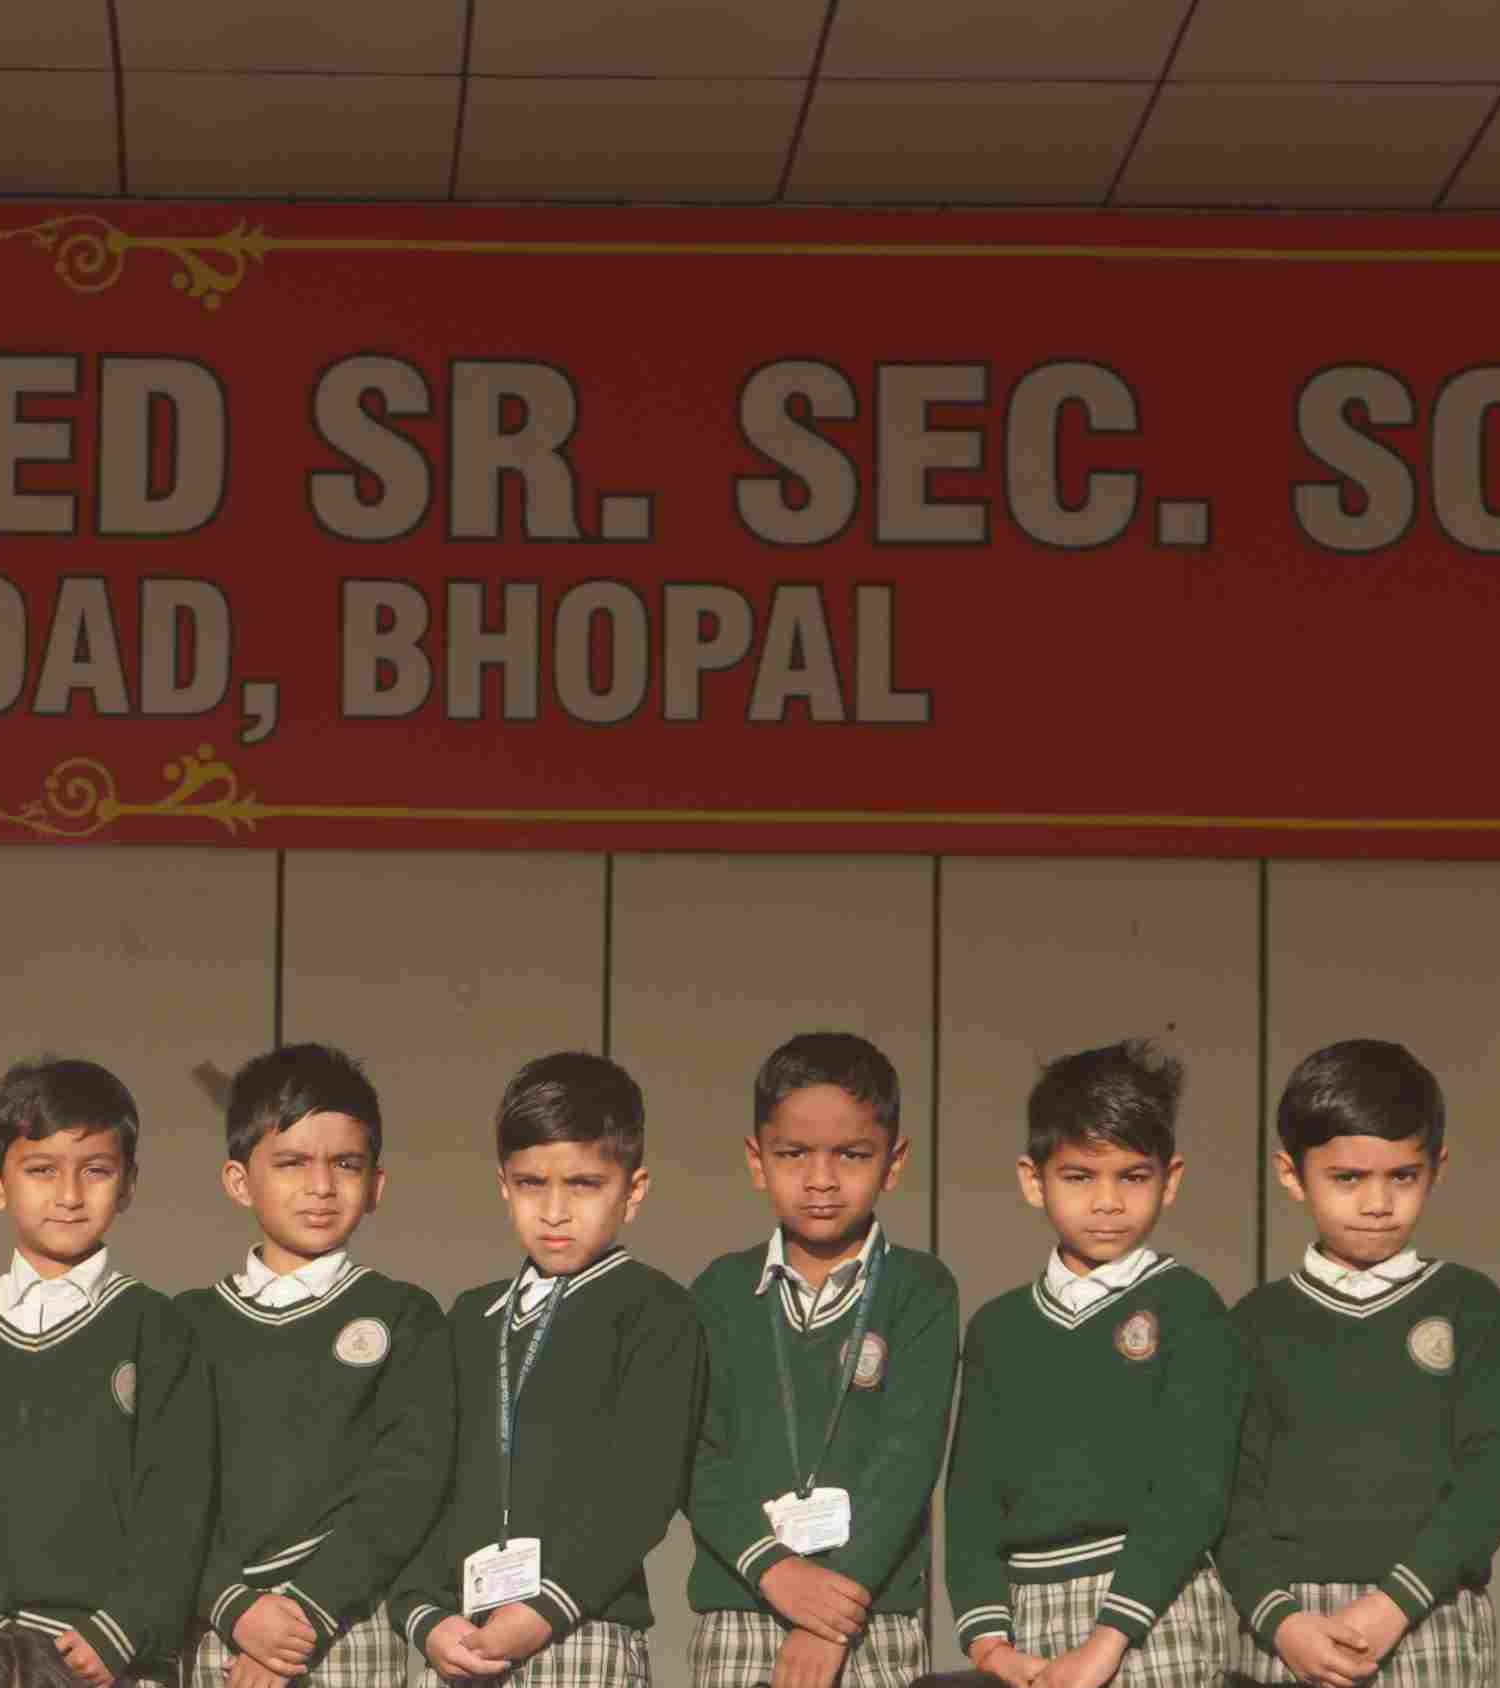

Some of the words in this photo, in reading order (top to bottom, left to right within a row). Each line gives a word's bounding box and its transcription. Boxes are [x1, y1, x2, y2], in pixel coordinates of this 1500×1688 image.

[307, 353, 653, 543] SR.
[734, 358, 1211, 550] SEC.
[340, 577, 933, 726] BHOPAL
